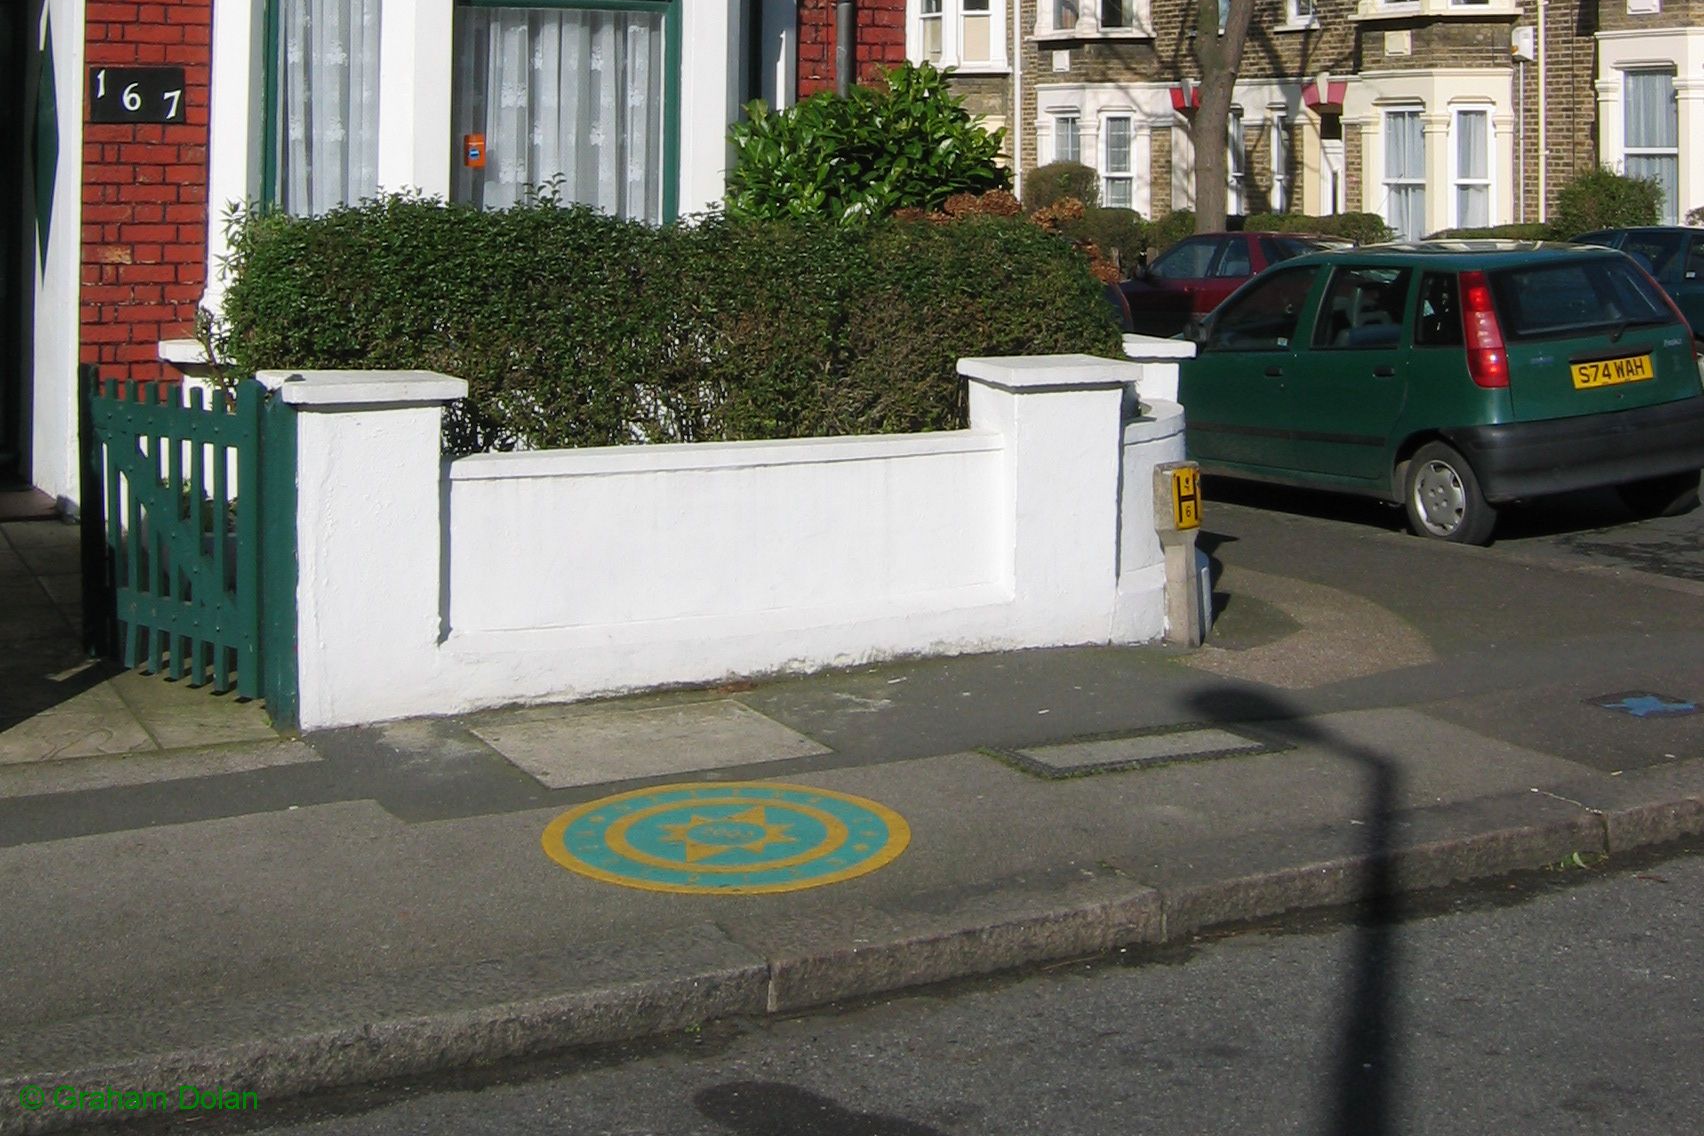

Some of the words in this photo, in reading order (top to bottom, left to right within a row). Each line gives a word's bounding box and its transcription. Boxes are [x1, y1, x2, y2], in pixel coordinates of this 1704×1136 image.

[97, 69, 182, 120] 167
[1578, 364, 1612, 384] S74
[1615, 358, 1645, 379] WAH
